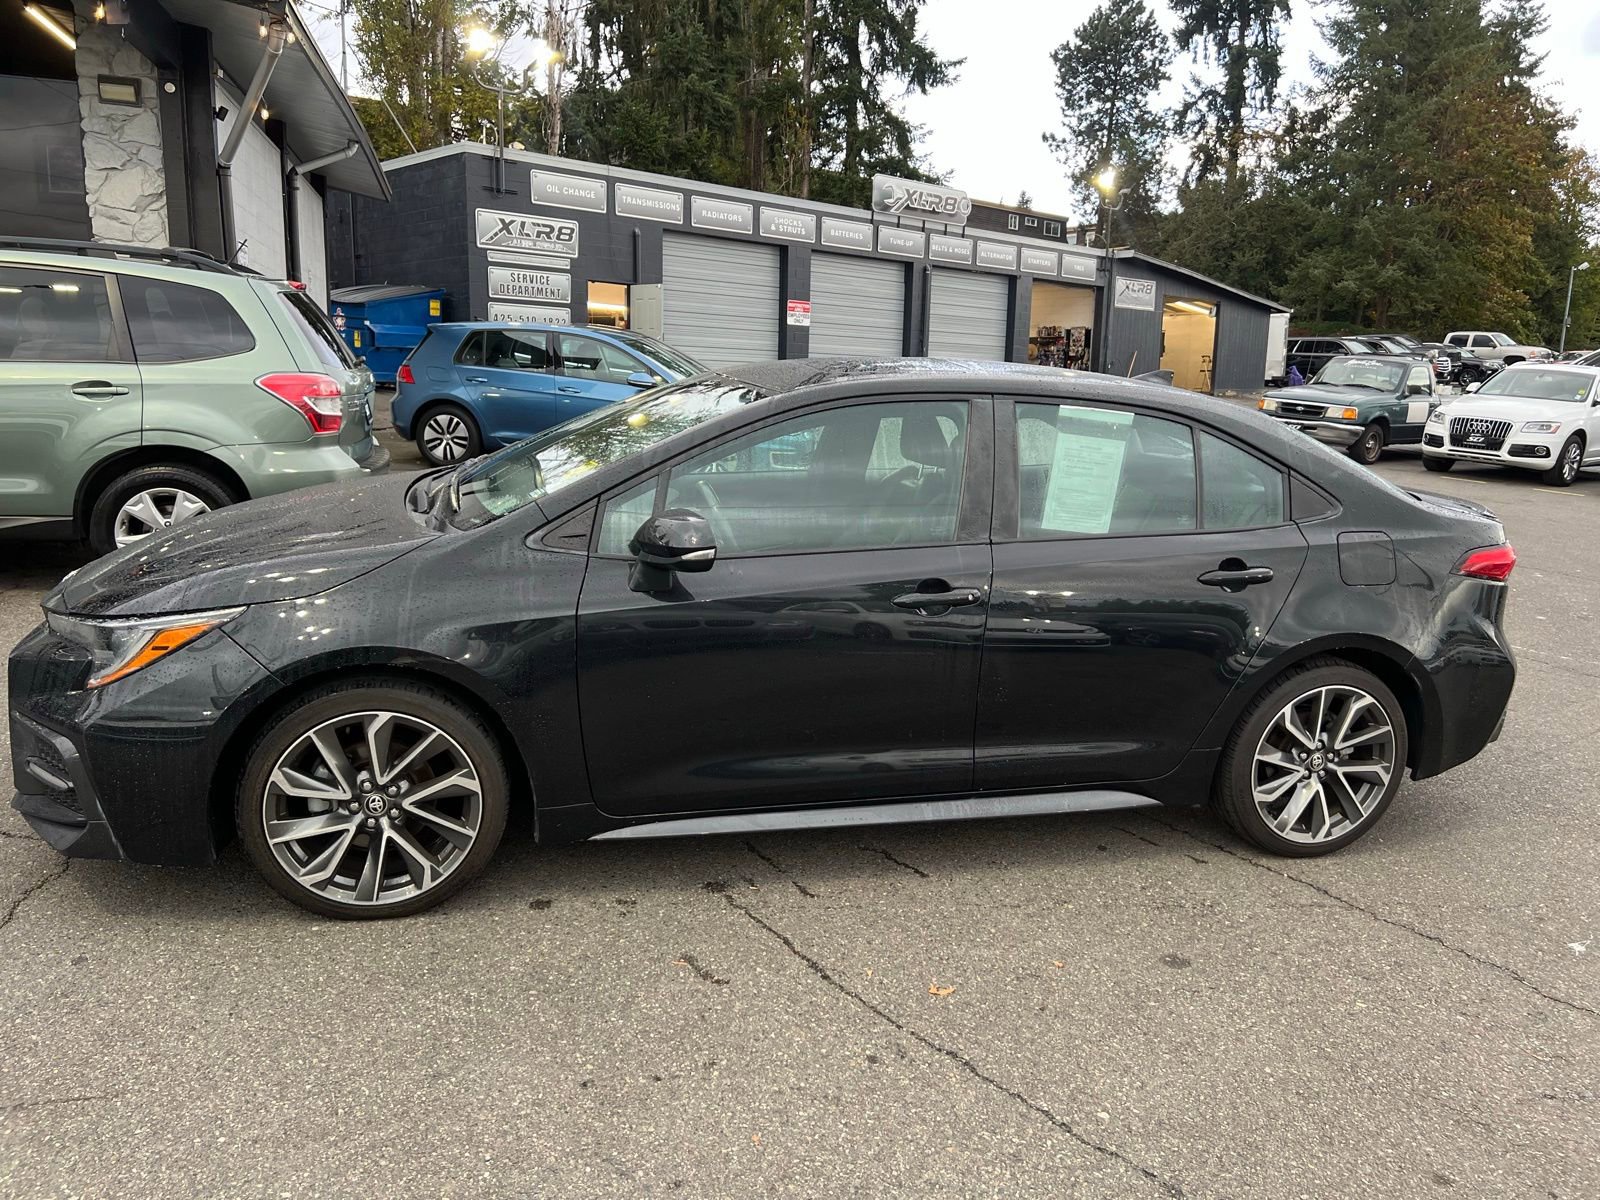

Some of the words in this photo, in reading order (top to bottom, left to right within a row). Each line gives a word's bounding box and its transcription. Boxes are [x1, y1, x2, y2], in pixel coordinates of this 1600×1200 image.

[546, 184, 560, 194] OIL
[563, 187, 596, 199] CHANGE
[622, 196, 681, 211] TRANSMISSIONS
[890, 187, 958, 214] XLR8
[702, 210, 742, 222] RADIATORS
[774, 216, 802, 227] SHOCKS
[481, 217, 576, 243] XLR8
[778, 224, 806, 235] STRUTS
[830, 229, 863, 240] BATTERIES
[889, 237, 914, 247] TUNE-UP
[932, 244, 948, 253] BELTS
[981, 251, 1013, 261] ALTERNATOR
[510, 272, 551, 285] SERVICE
[499, 284, 561, 298] DEPARTMENT
